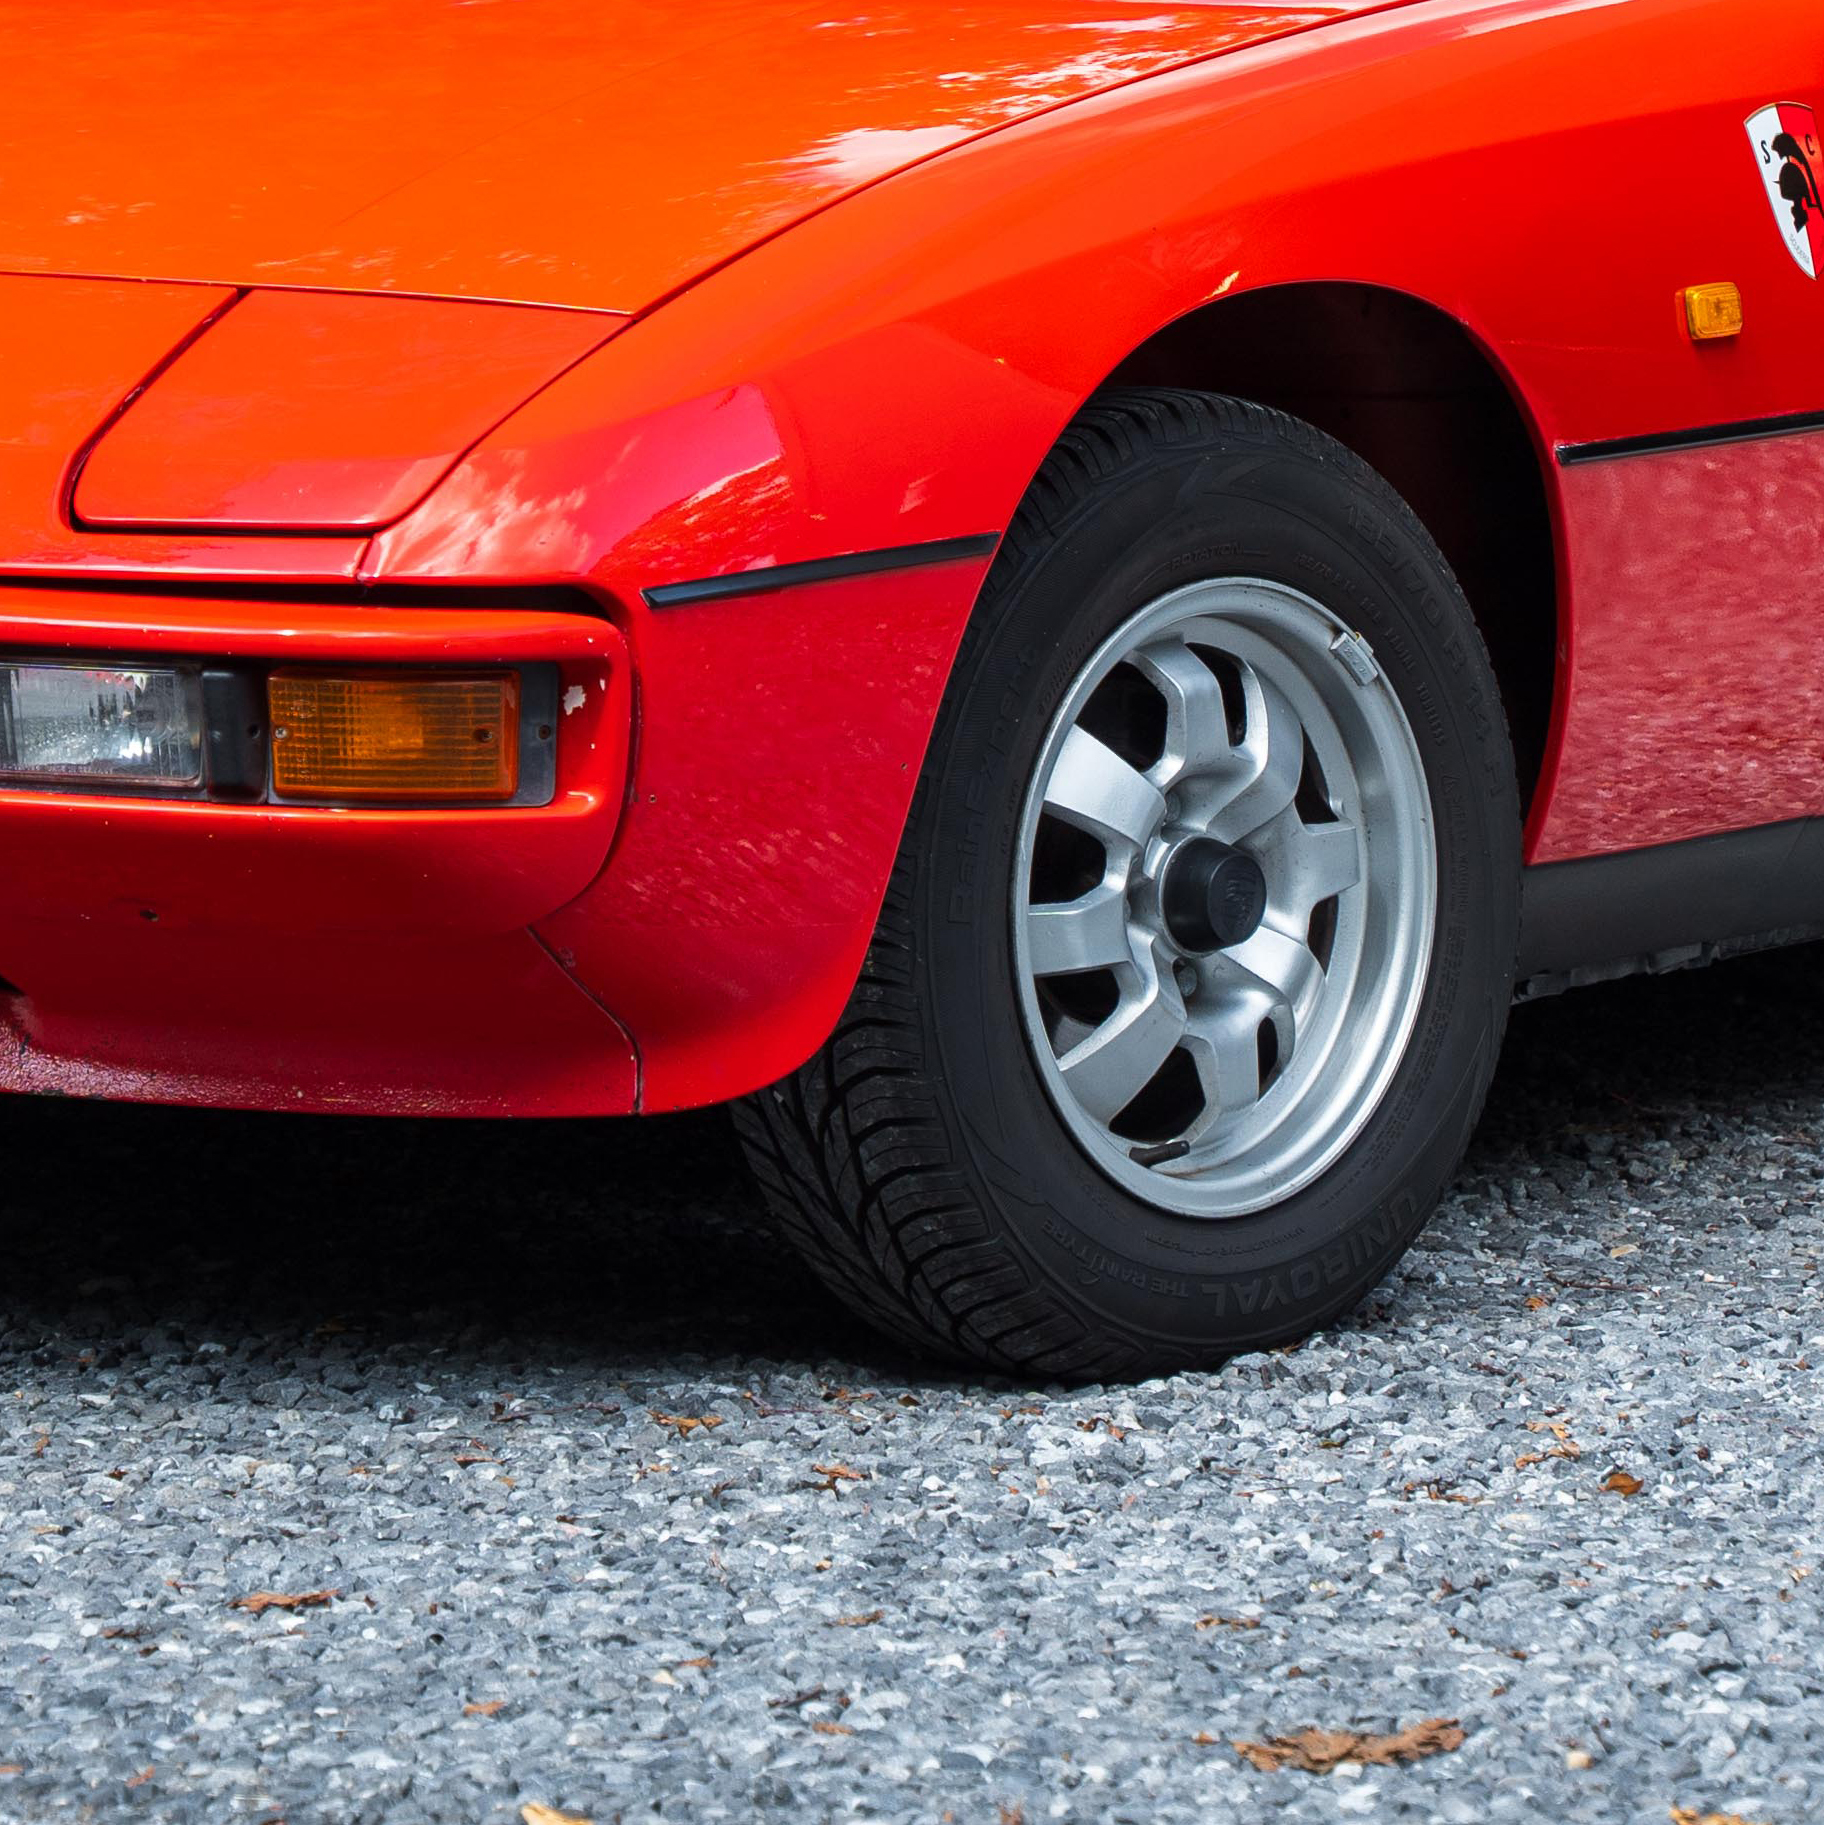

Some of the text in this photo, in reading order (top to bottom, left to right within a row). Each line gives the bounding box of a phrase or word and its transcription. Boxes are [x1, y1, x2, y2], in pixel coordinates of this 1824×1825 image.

[1760, 133, 1815, 164] S C
[1201, 1186, 1418, 1318] UNIROYAL
[1151, 1277, 1189, 1298] THE
